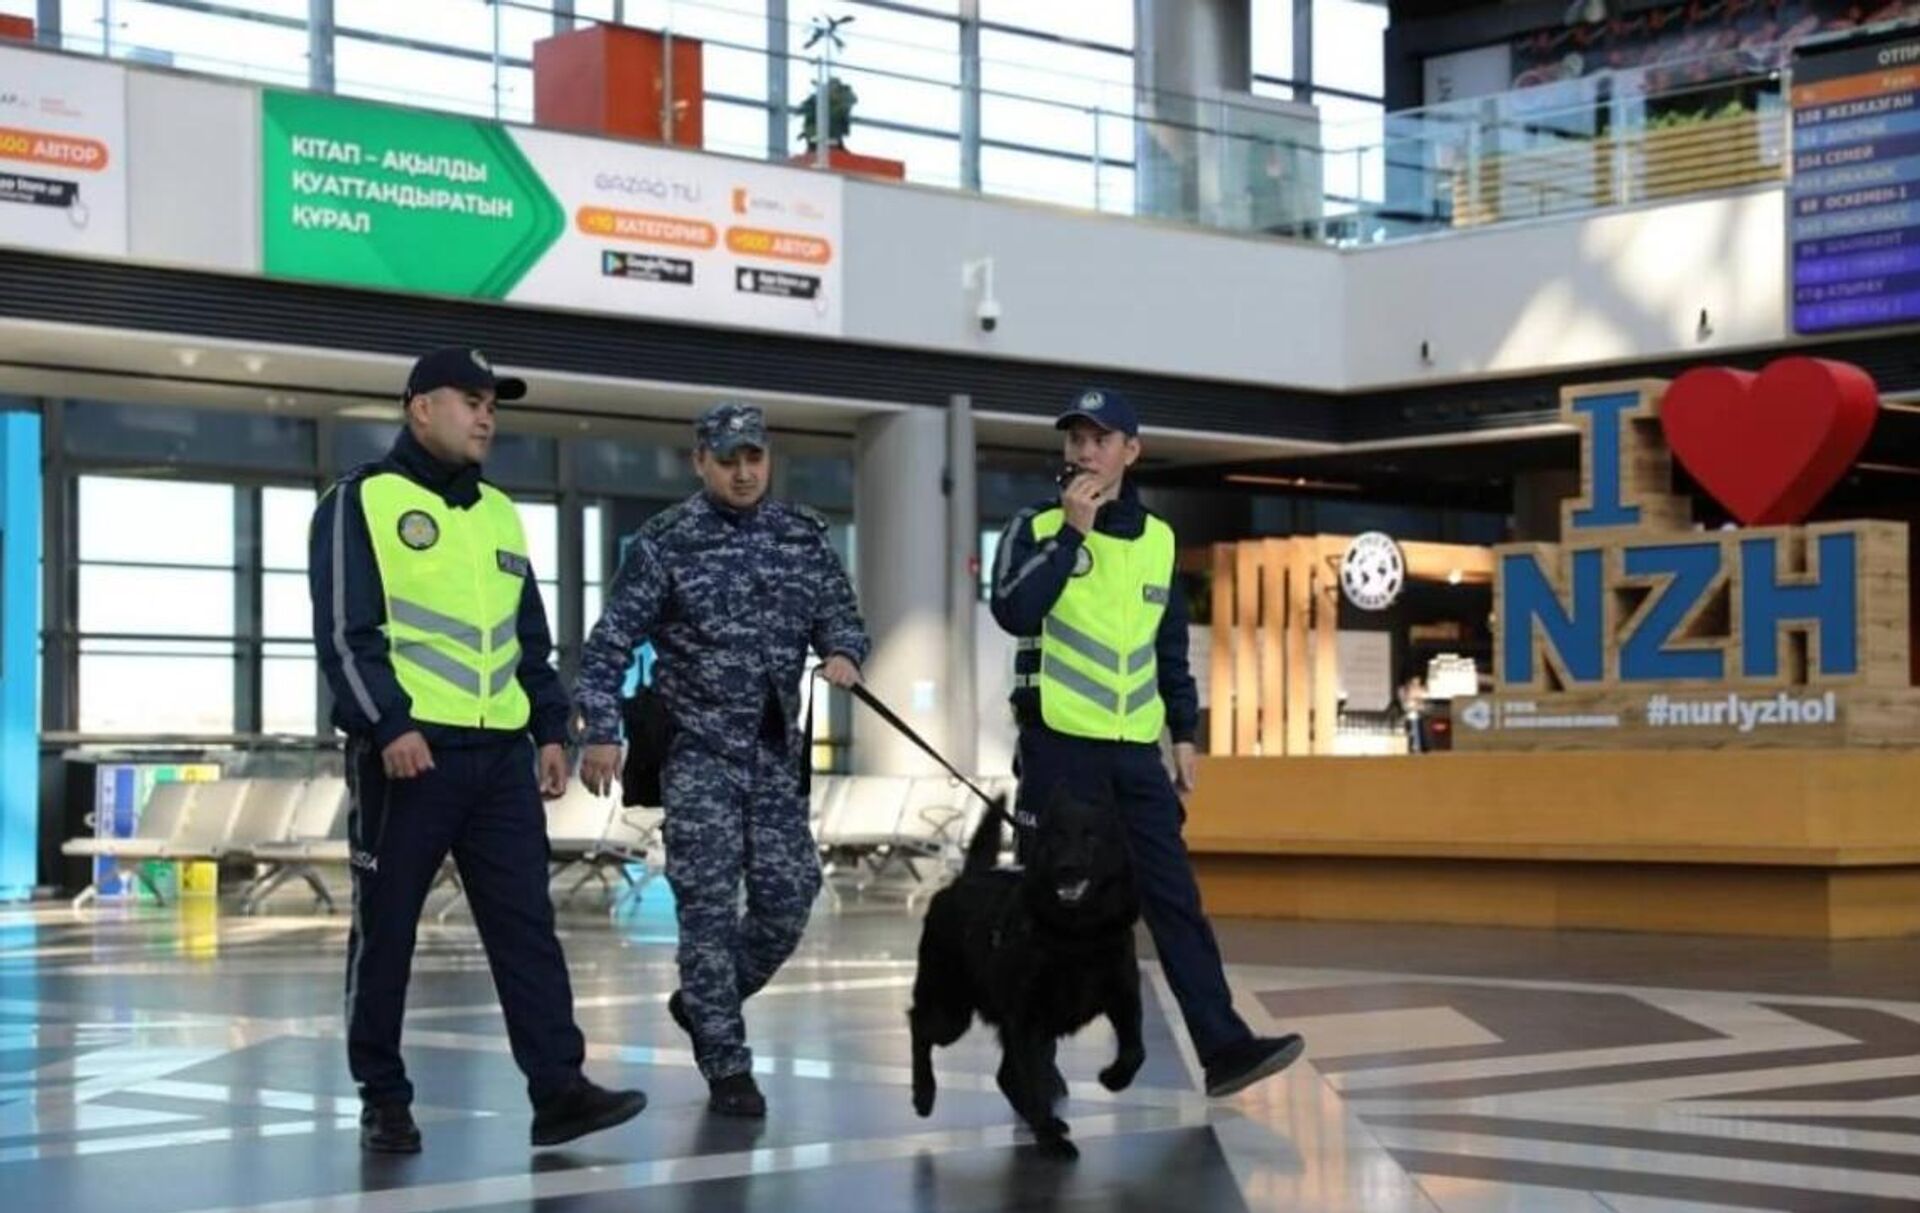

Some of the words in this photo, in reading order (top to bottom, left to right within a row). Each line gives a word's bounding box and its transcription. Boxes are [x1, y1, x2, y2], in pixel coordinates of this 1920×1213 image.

[292, 136, 361, 163] КІТАП
[382, 150, 487, 183] АҚЫЛДЫ
[292, 171, 513, 219] ҚУАТТАНДЫРАТЫН
[292, 203, 371, 233] ҚҰРАЛ
[1573, 391, 1640, 527] I
[1503, 532, 1858, 683] NZH
[1647, 691, 1836, 732] #nurlyzhol
